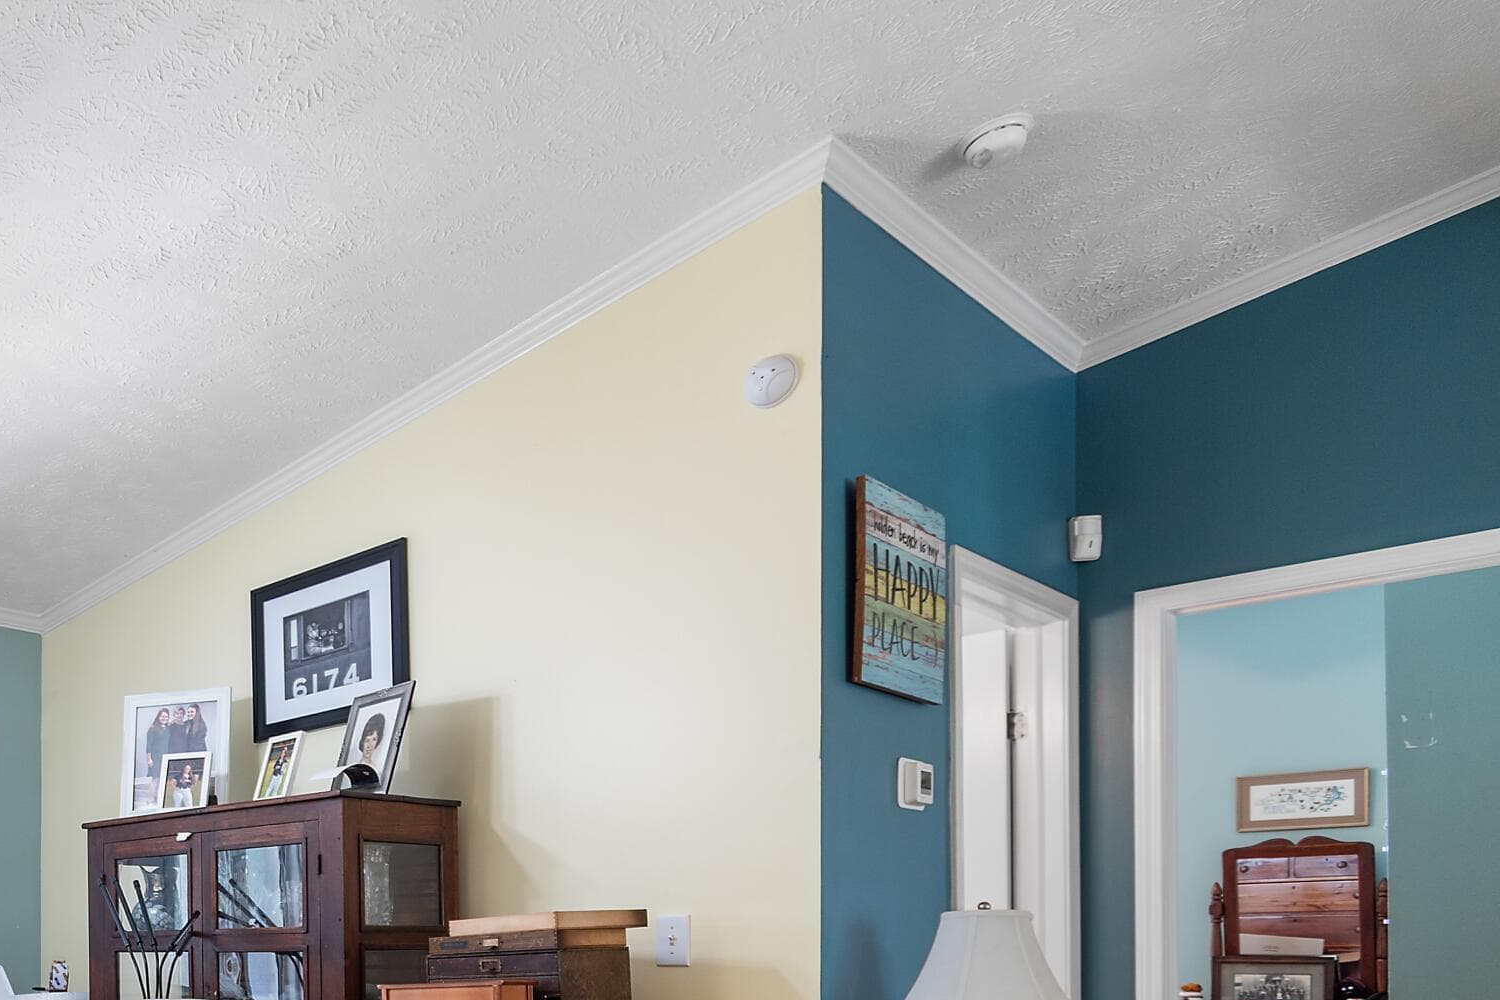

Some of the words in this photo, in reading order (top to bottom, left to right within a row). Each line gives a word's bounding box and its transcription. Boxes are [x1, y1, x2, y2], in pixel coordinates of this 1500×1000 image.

[899, 522, 918, 549] beach
[920, 536, 926, 553] is
[928, 543, 940, 566] my
[873, 542, 940, 620] HAPPY
[871, 611, 921, 661] PLACE
[293, 663, 359, 698] 6174
